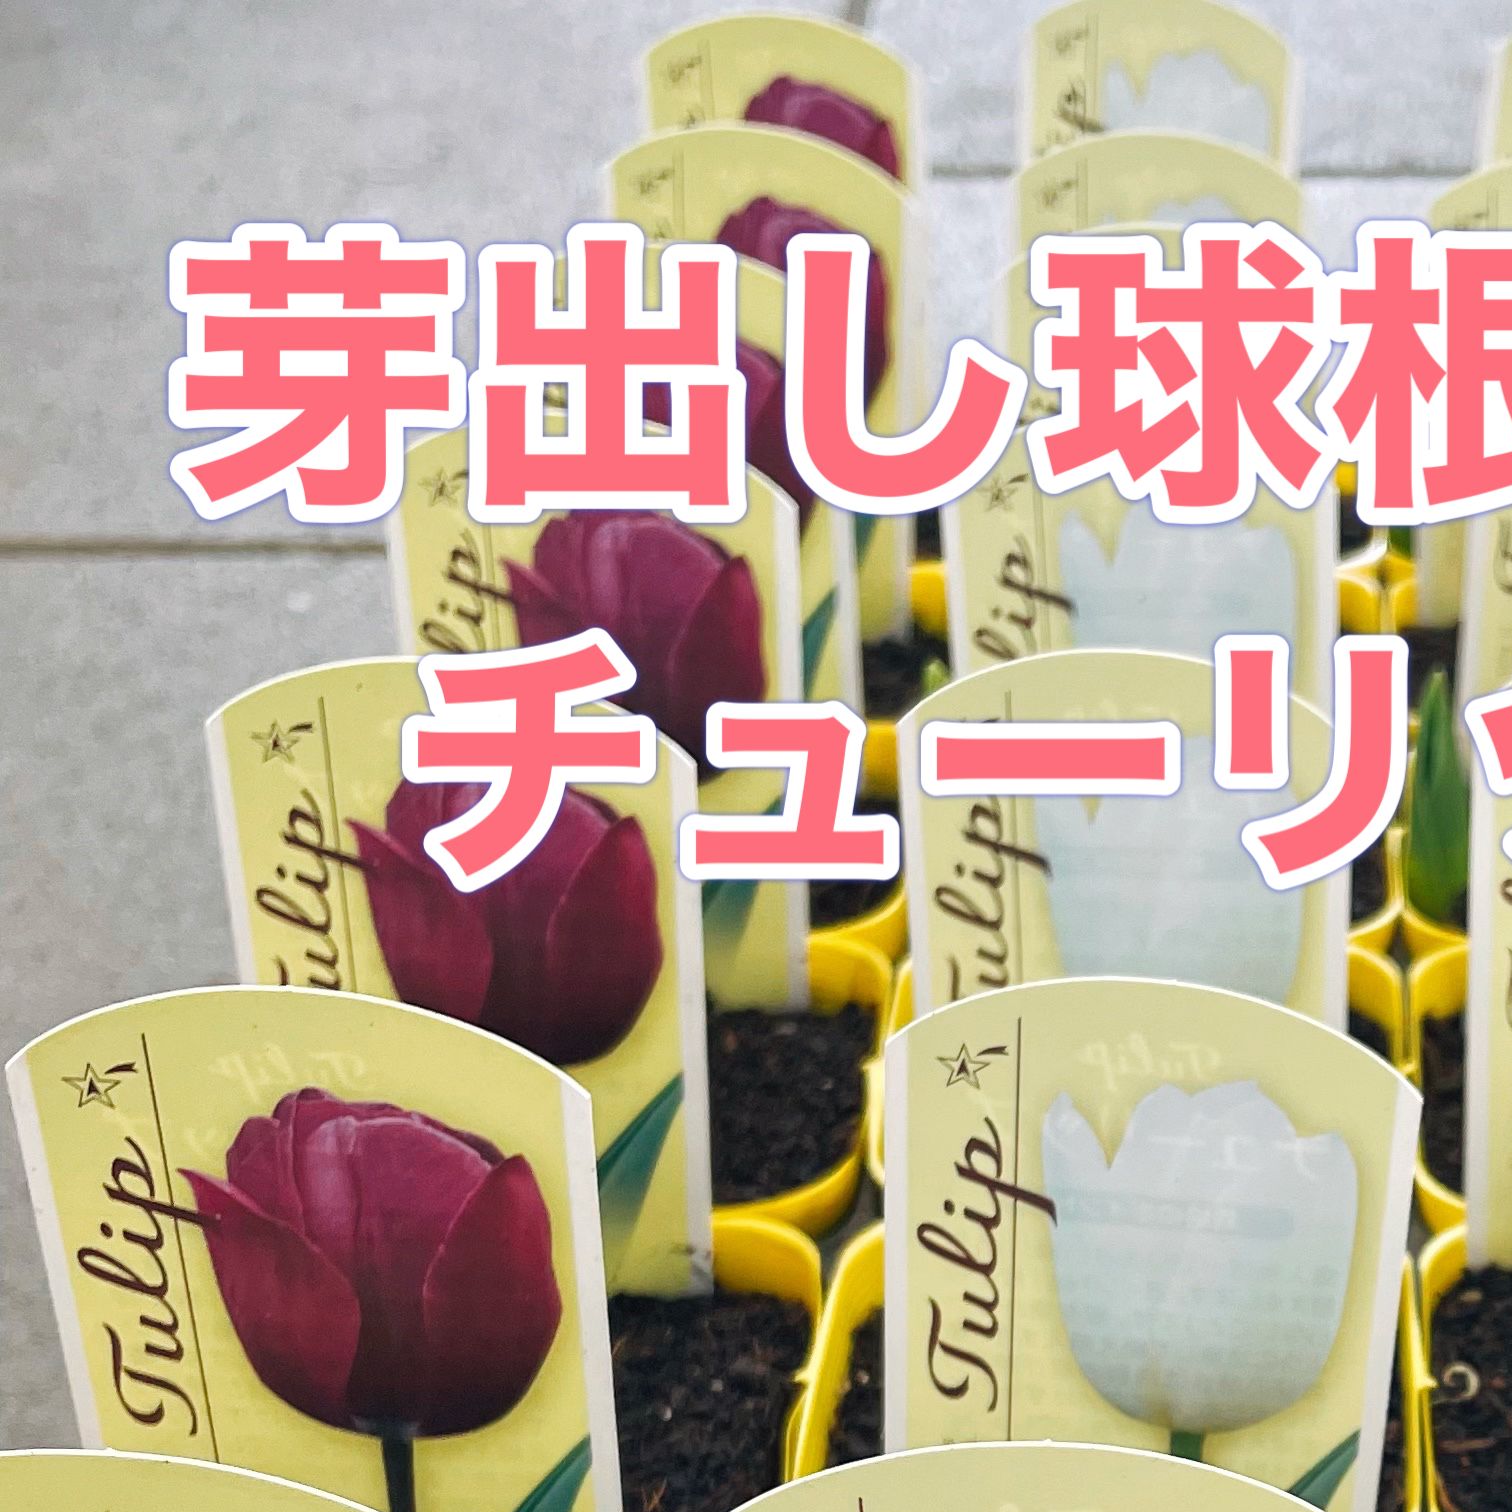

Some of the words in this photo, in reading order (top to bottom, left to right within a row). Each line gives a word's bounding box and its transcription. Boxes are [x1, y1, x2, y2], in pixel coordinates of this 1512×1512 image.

[255, 787, 380, 991] ulip
[76, 1136, 221, 1436] Tulip
[916, 1116, 1059, 1412] Tulip
